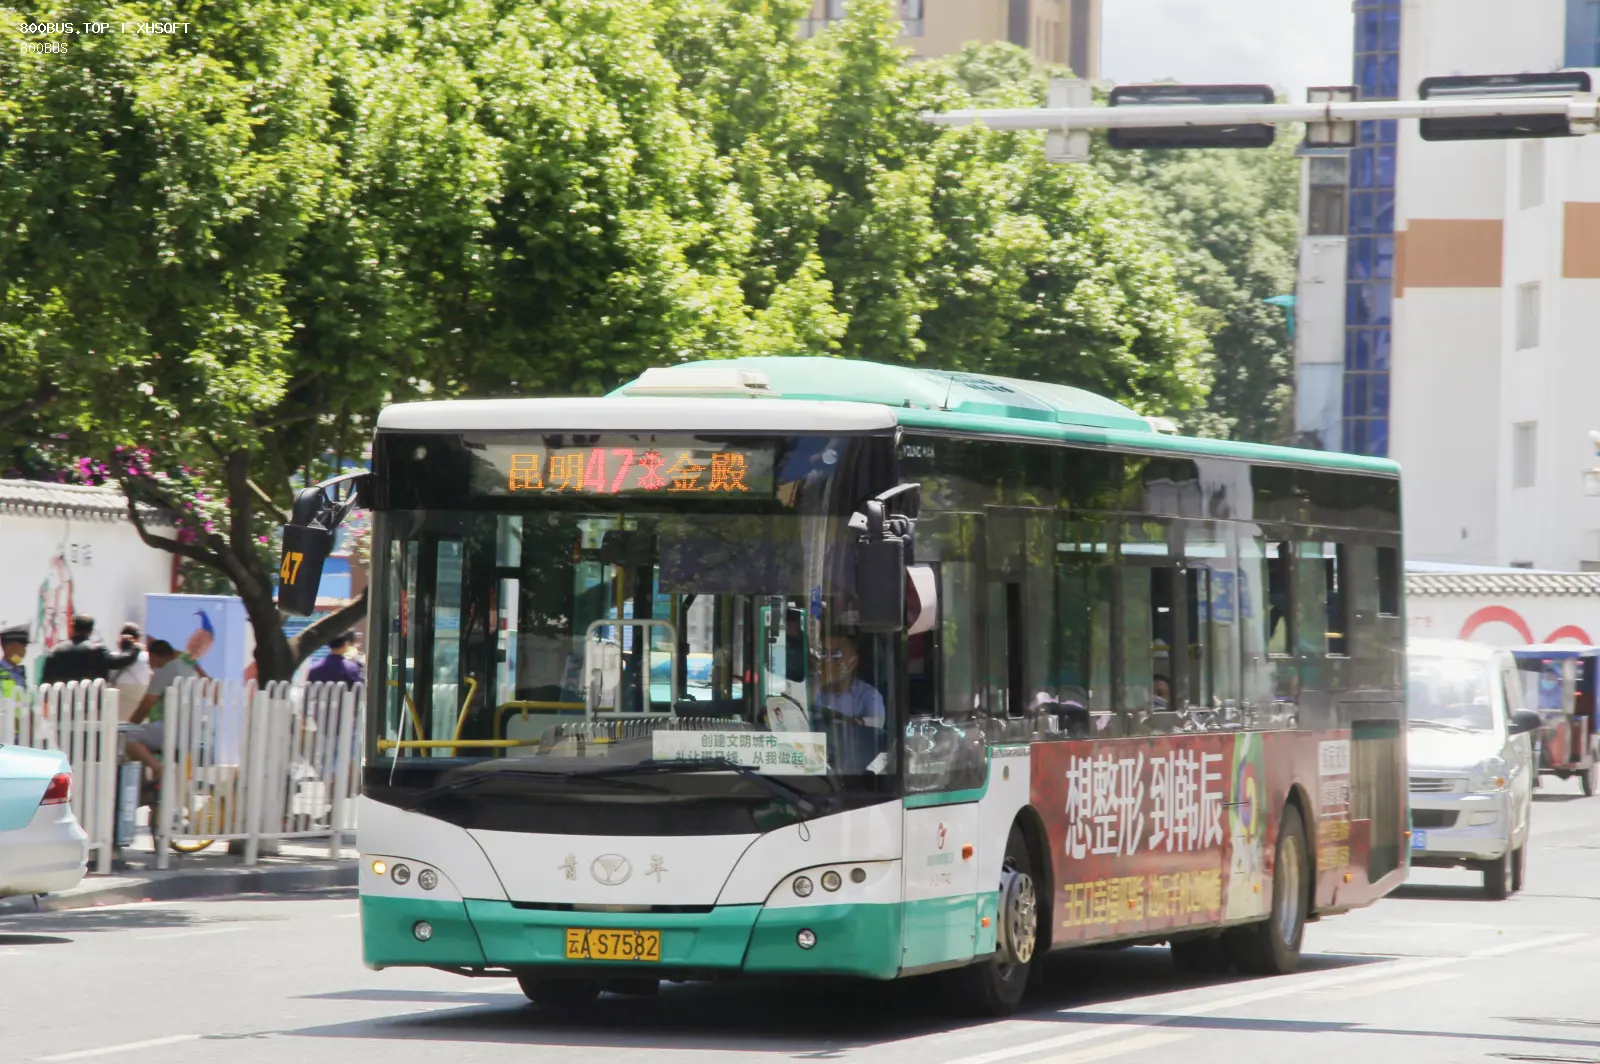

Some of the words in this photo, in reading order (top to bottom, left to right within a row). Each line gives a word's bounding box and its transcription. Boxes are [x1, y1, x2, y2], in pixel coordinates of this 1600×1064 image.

[509, 453, 584, 491] 昆明
[583, 448, 634, 493] 47
[666, 452, 748, 491] 金殿
[280, 551, 304, 585] 47
[701, 734, 778, 748] 创建文明城市
[1065, 752, 1144, 860] 想整形
[1149, 749, 1223, 853] 到韩辰
